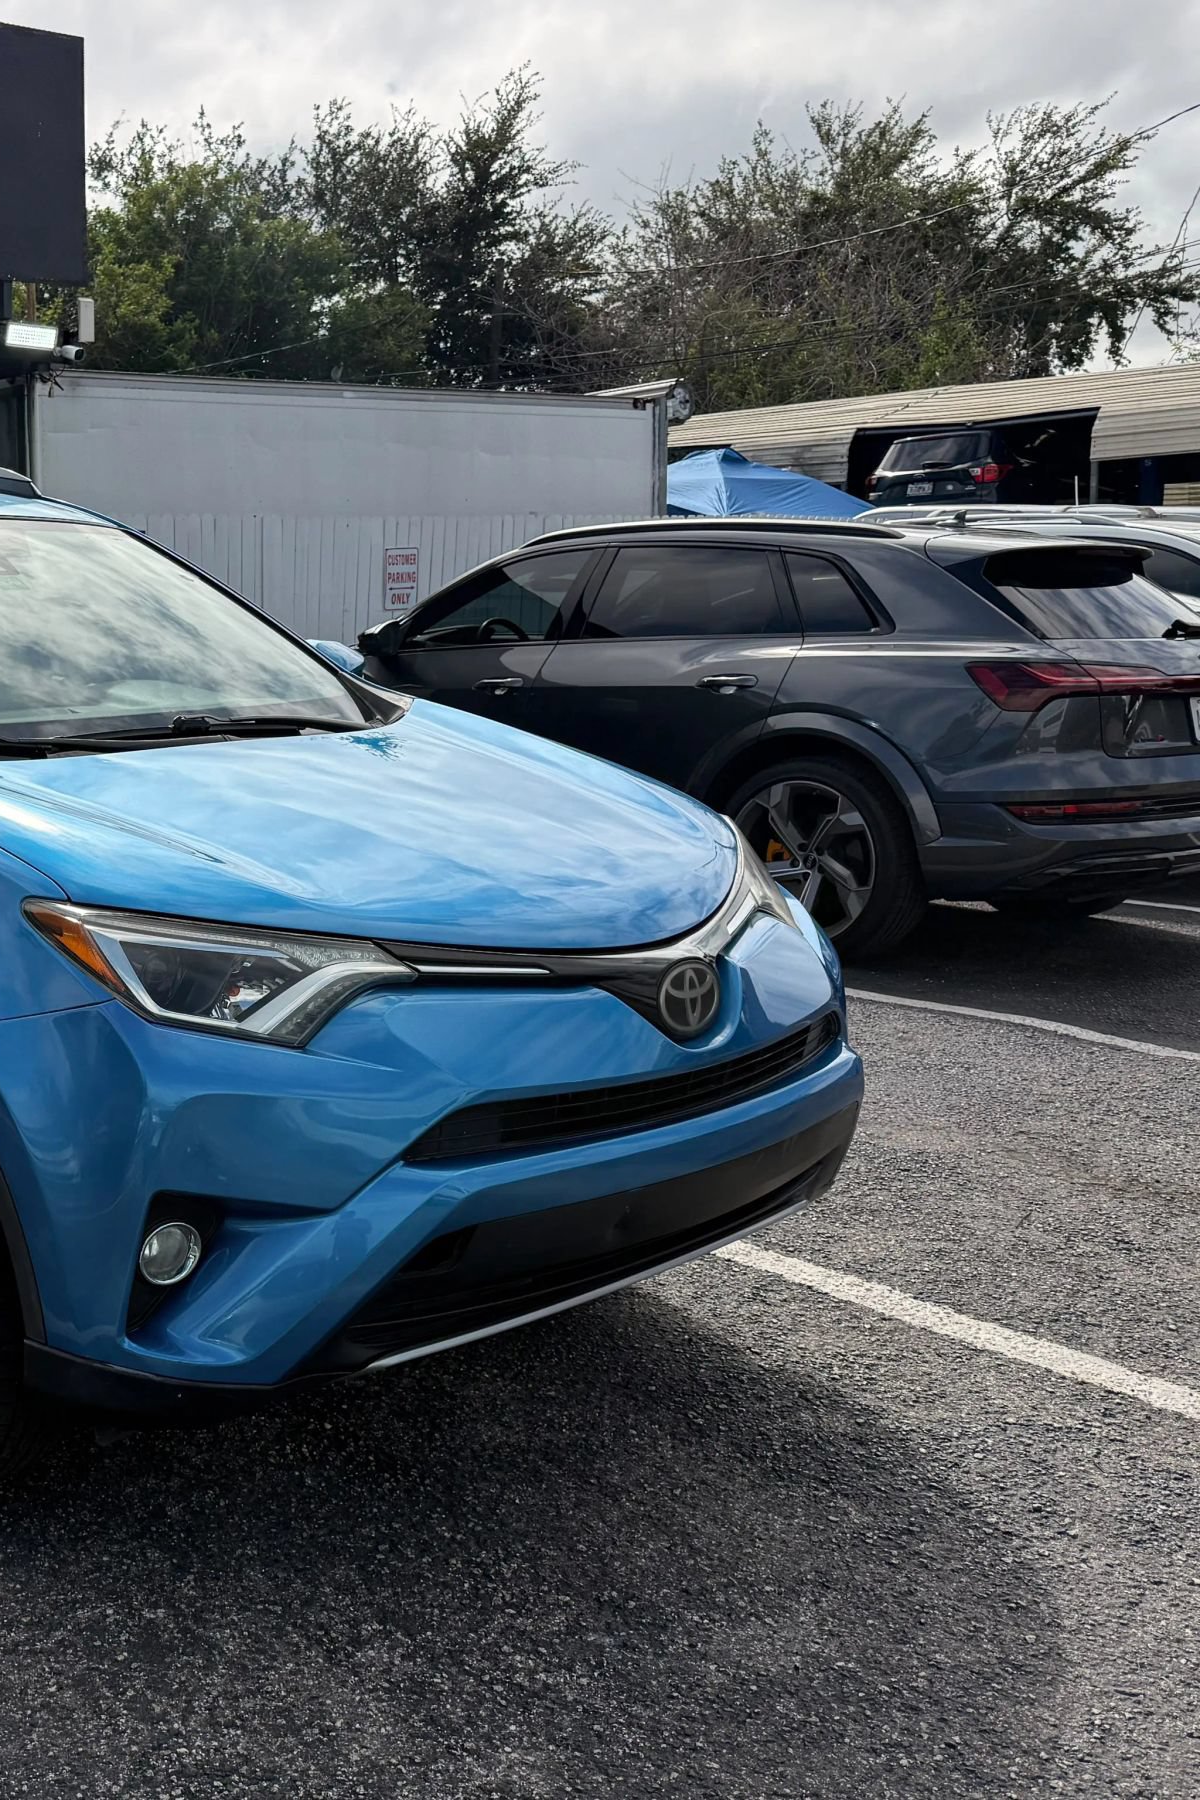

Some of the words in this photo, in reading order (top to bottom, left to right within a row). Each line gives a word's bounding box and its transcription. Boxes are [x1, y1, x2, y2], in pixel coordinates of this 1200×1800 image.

[388, 553, 416, 566] CUSTOMER
[388, 571, 416, 584] PARKING
[392, 593, 410, 605] ONLY
